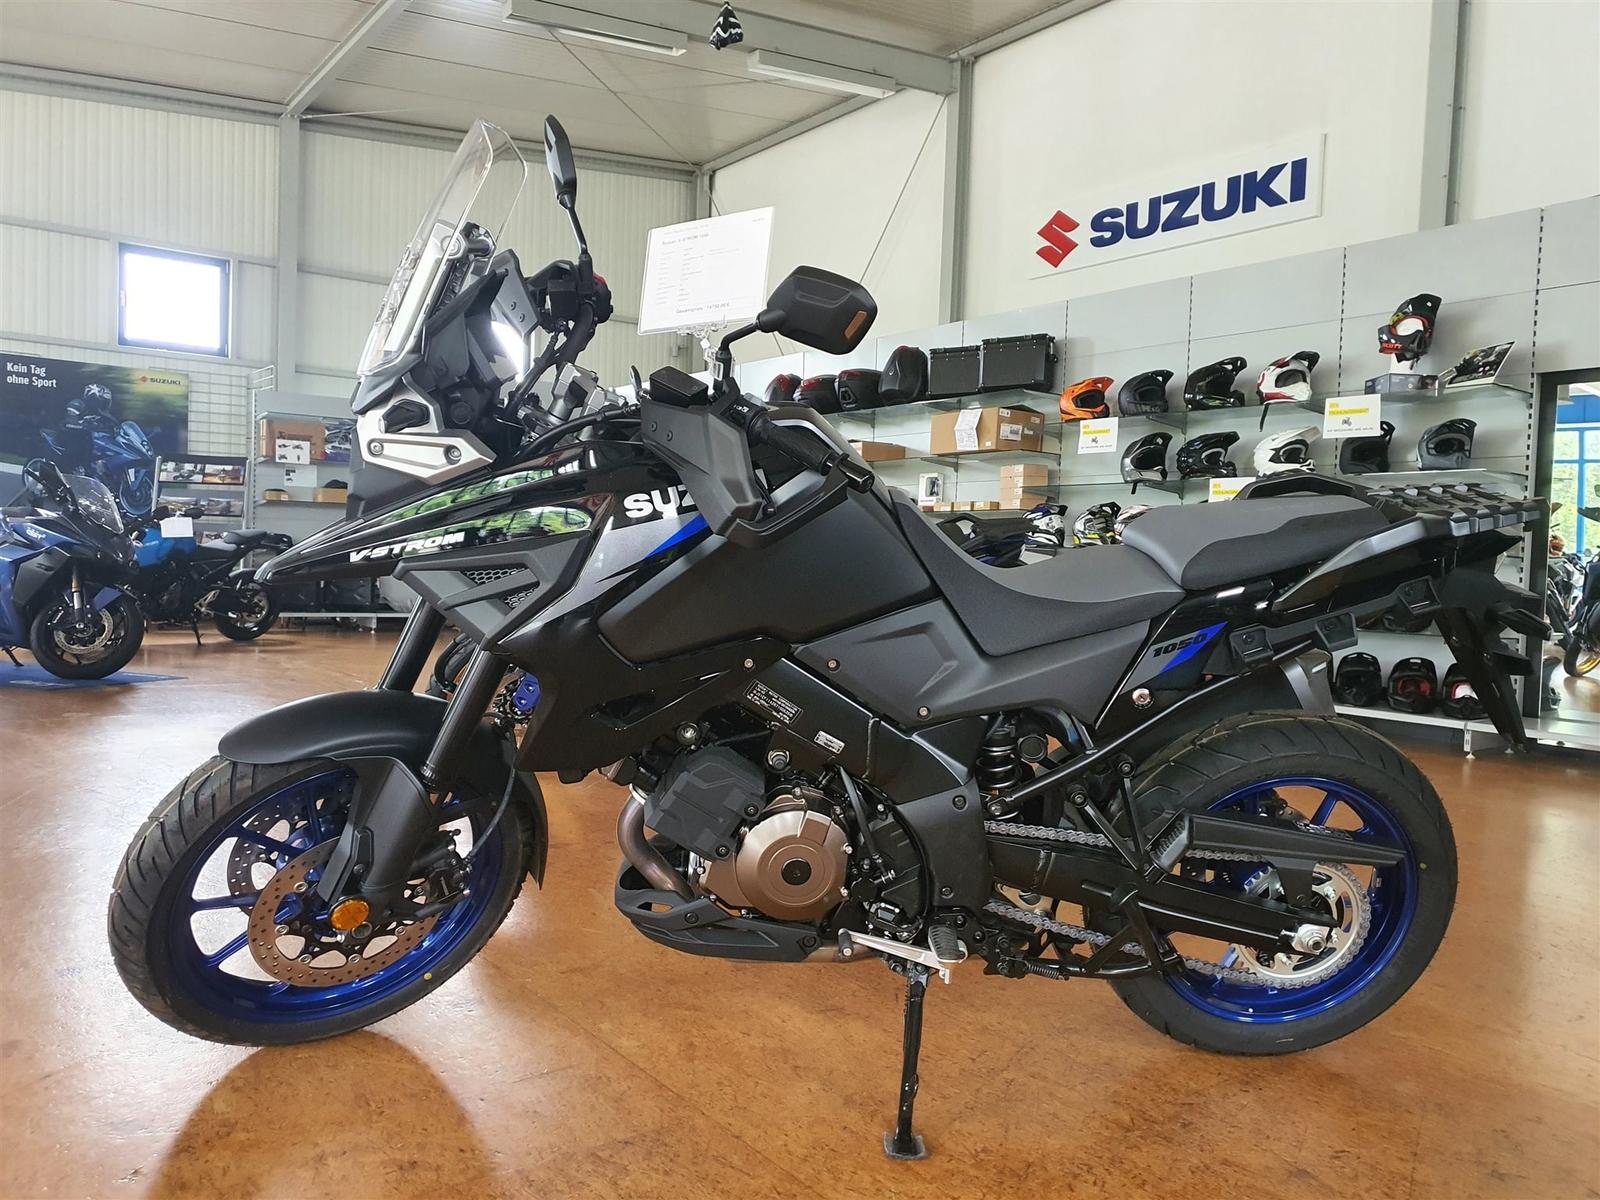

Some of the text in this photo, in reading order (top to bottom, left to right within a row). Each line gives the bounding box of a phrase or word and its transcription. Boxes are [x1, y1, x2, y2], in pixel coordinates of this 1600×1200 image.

[1089, 157, 1308, 248] SUZUKI
[6, 362, 46, 377] Kein Tag
[6, 374, 57, 388] ohne Sport
[149, 377, 181, 385] SUZUKI
[349, 531, 465, 563] V-STROM
[1152, 633, 1208, 658] 1050
